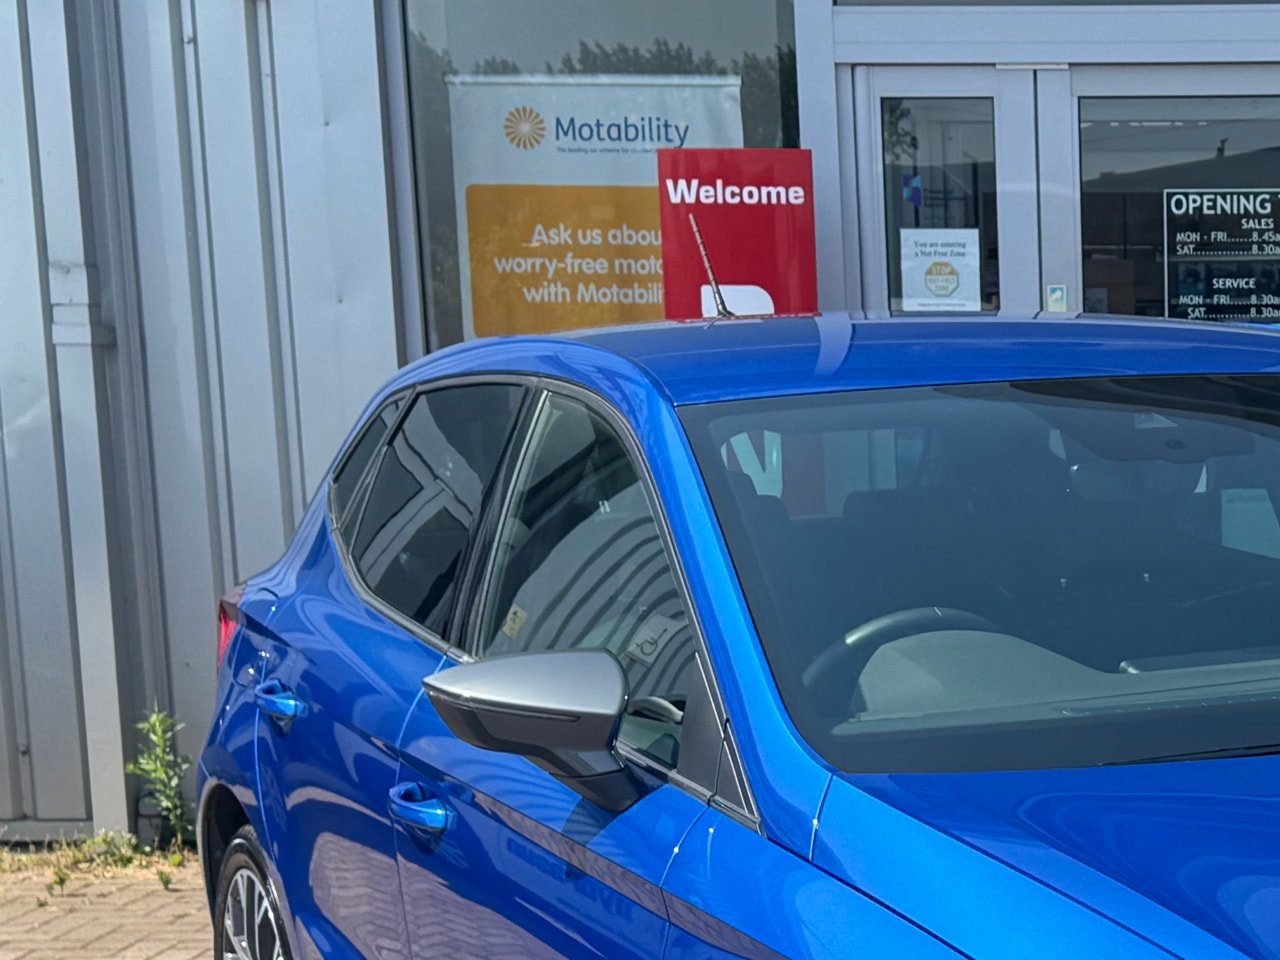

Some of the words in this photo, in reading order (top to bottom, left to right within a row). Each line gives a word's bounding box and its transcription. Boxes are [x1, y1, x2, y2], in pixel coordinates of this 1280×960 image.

[555, 116, 689, 148] Motability
[665, 179, 805, 205] Welcome
[1171, 194, 1272, 215] OPENING
[532, 223, 573, 245] Ask
[578, 229, 602, 245] us
[608, 223, 662, 245] abou
[1241, 218, 1274, 229] SALES
[1176, 231, 1200, 242] MON
[494, 252, 608, 279] worry-free
[522, 281, 571, 304] with
[577, 282, 664, 304] Motabili
[1212, 278, 1256, 289] SERVICE
[1179, 294, 1203, 305] MON
